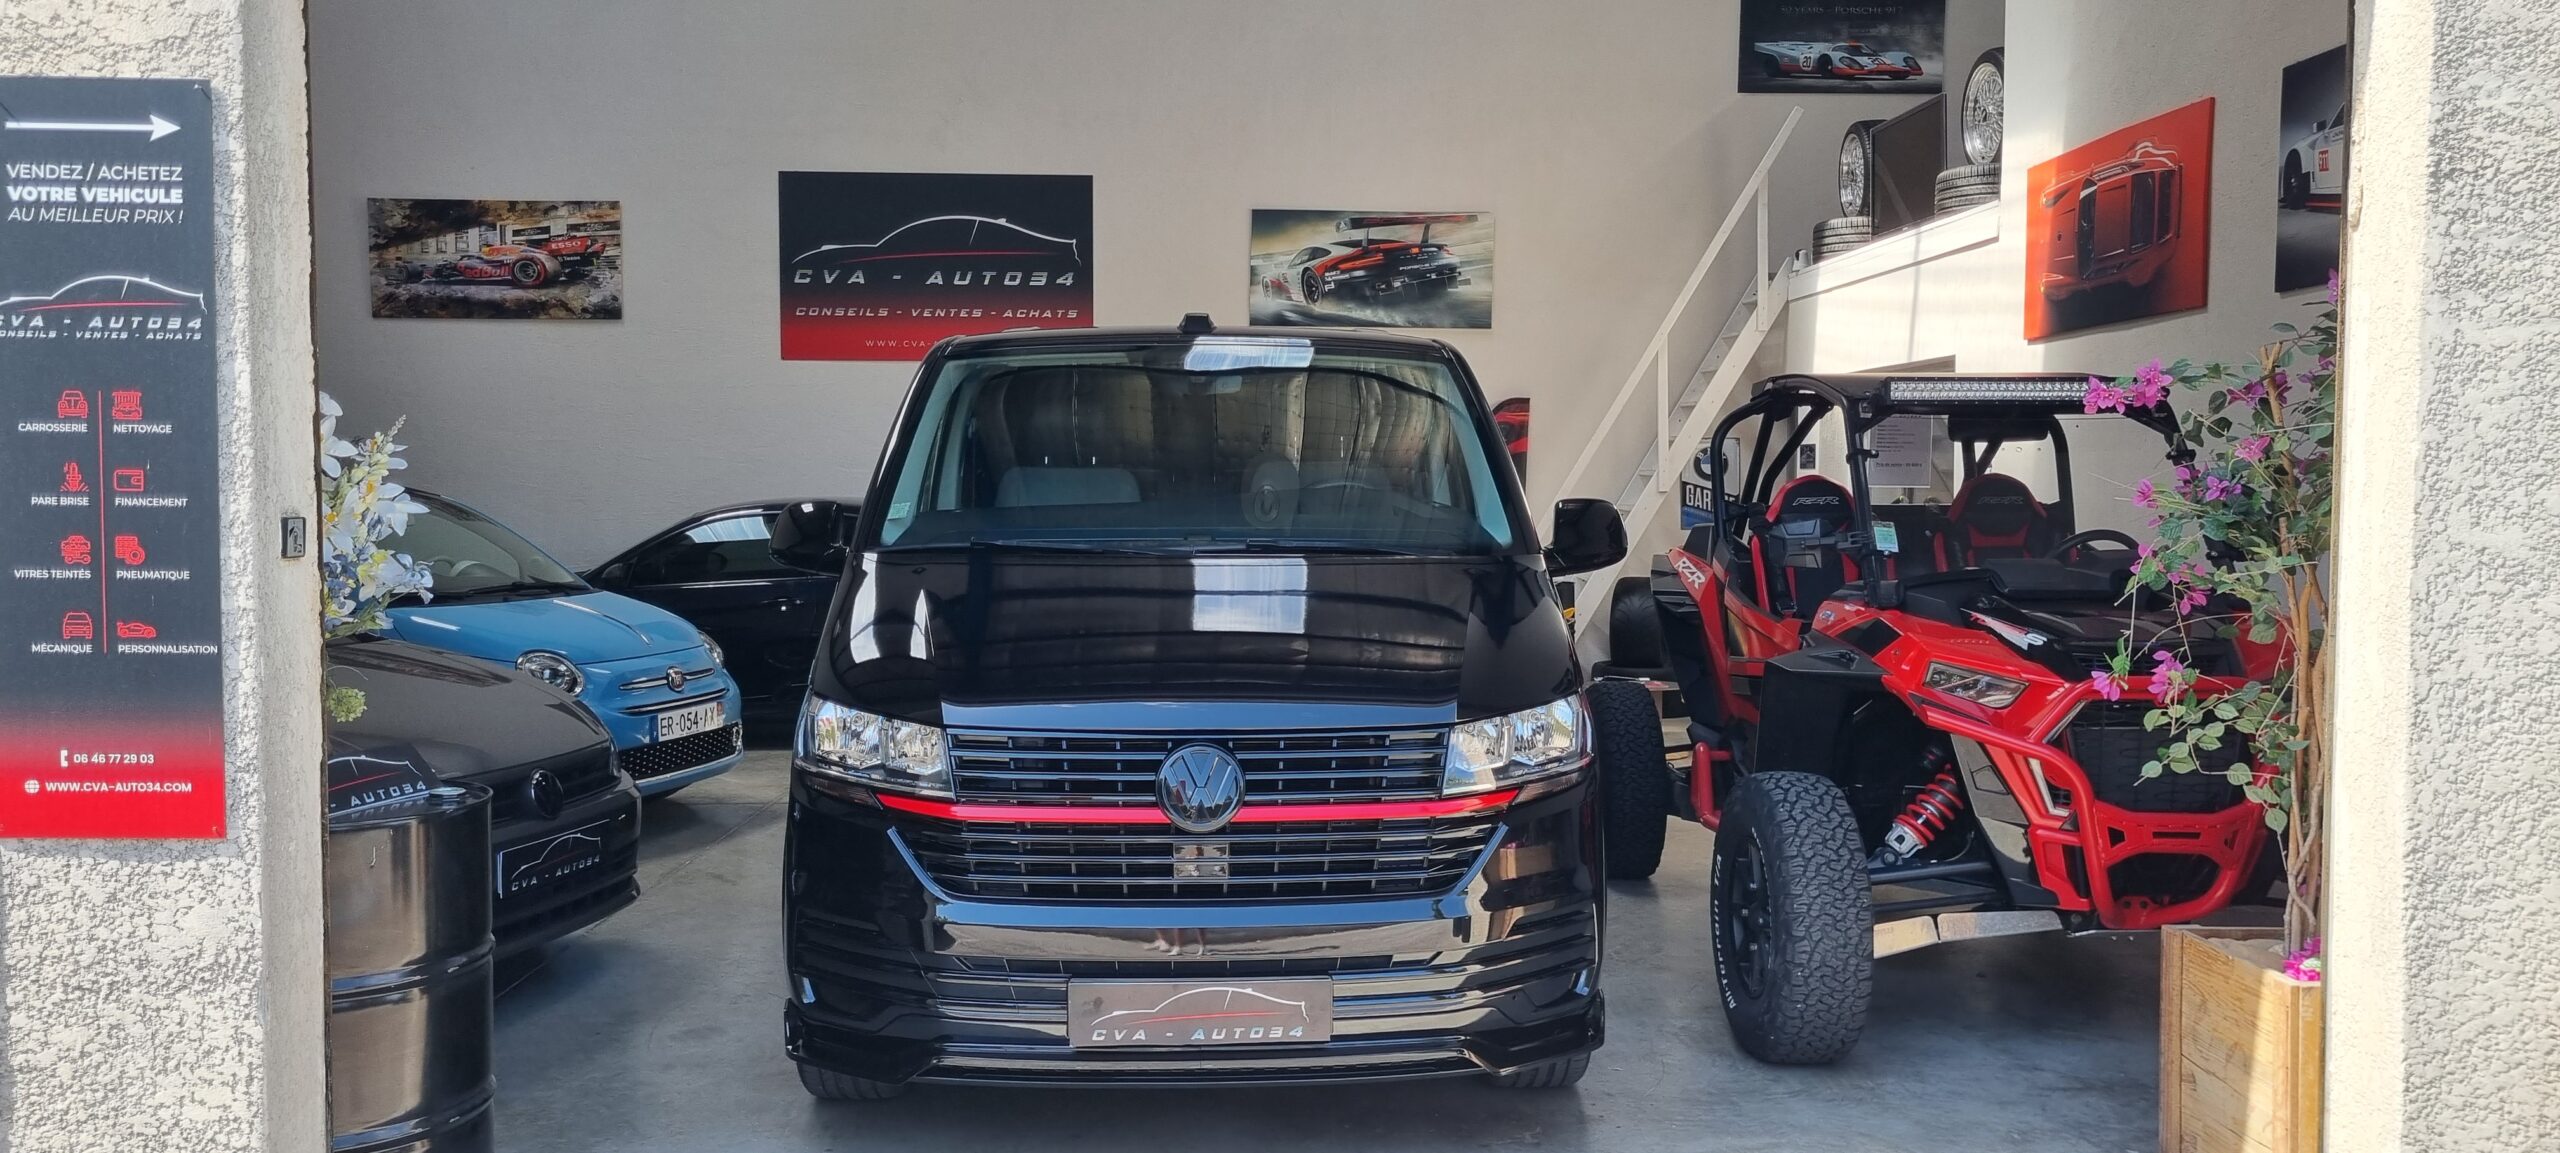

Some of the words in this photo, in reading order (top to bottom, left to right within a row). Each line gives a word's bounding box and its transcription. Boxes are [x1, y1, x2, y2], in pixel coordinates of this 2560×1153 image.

[1834, 6, 1884, 14] PORSCHE
[1802, 56, 1812, 70] 20
[1867, 57, 1886, 65] 20
[6, 164, 83, 180] VENDEZ
[86, 163, 95, 180] /
[98, 165, 183, 181] ACHETEZ
[6, 186, 77, 202] VOTRE
[82, 187, 184, 204] VEHICULE
[8, 207, 35, 222] AU
[38, 207, 130, 223] MEILLEUR
[551, 241, 582, 250] ESSO
[793, 269, 866, 284] CVA
[925, 271, 1075, 286] AUTO34
[796, 307, 889, 317] CONSEILS
[911, 308, 983, 318] VENTES
[1003, 309, 1079, 319] ACHATS
[88, 316, 202, 330] AUTO34
[0, 330, 57, 338] ONSEILS
[75, 331, 129, 339] VENTES
[145, 332, 202, 341] ACHATS
[18, 423, 88, 433] CARROSSERIE
[113, 424, 173, 434] NETTOYAGE
[31, 496, 58, 506] PARE
[60, 497, 90, 506] BRISE
[115, 498, 188, 507] FINANCEMENT
[14, 569, 49, 579] VITRES
[51, 567, 91, 579] TEINTÉS
[116, 570, 191, 581] PNEUMATIQUE
[1674, 557, 1706, 590] RZR
[31, 641, 93, 653] MÉCANIQUE
[118, 644, 218, 655] PERSONNALISATION
[73, 754, 89, 764] 06
[91, 754, 106, 764] 46
[108, 754, 122, 764] 77
[124, 754, 138, 764] 29
[140, 754, 154, 764] 03
[45, 782, 192, 793] WWW.CVA-AUTO34.COM
[350, 780, 427, 807] AUTO34
[511, 876, 538, 891] CVA
[555, 855, 601, 877] AUTO34
[1091, 1029, 1147, 1042] CVA
[1190, 1025, 1304, 1040] AUTO34
